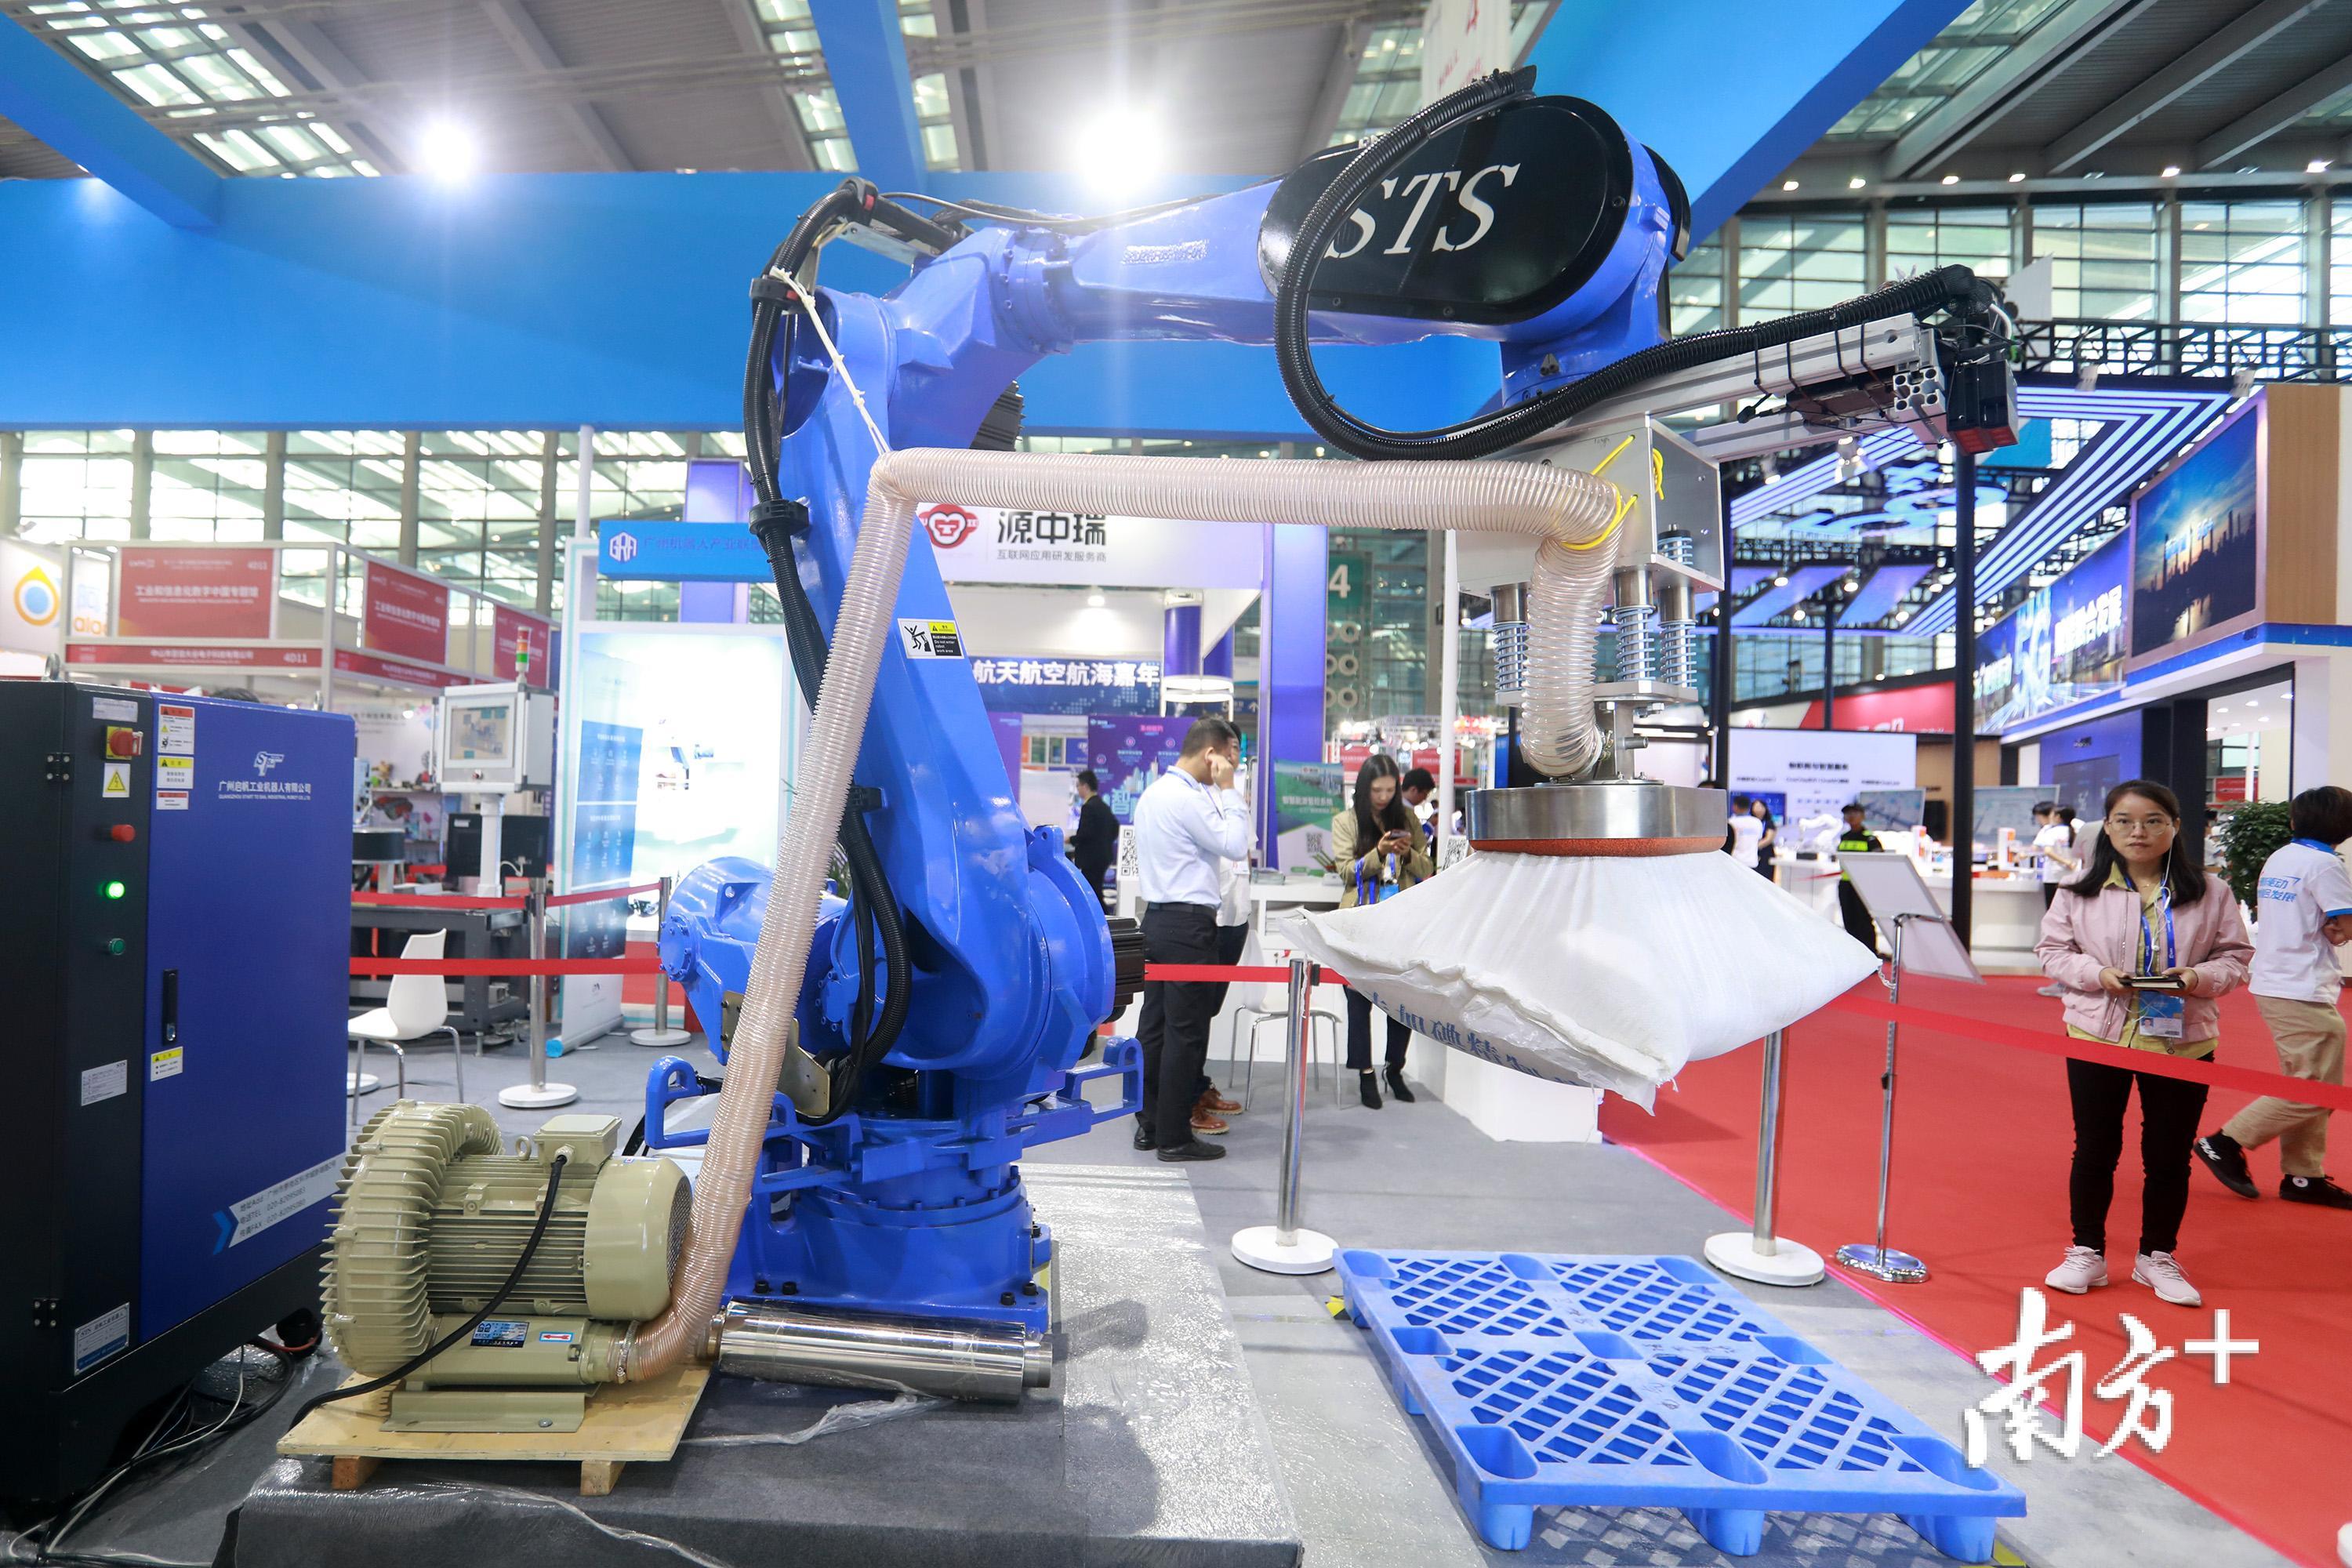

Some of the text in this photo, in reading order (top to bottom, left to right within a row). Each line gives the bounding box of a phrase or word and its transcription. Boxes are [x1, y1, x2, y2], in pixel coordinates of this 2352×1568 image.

[1328, 163, 1522, 260] STS
[997, 511, 1107, 546] 源中瑞
[996, 550, 1107, 562] 互联网应用研发服务商
[1329, 564, 1351, 599] 4
[283, 652, 308, 663] 4D11
[219, 780, 312, 793] 广州启帆工业机器人有限公司
